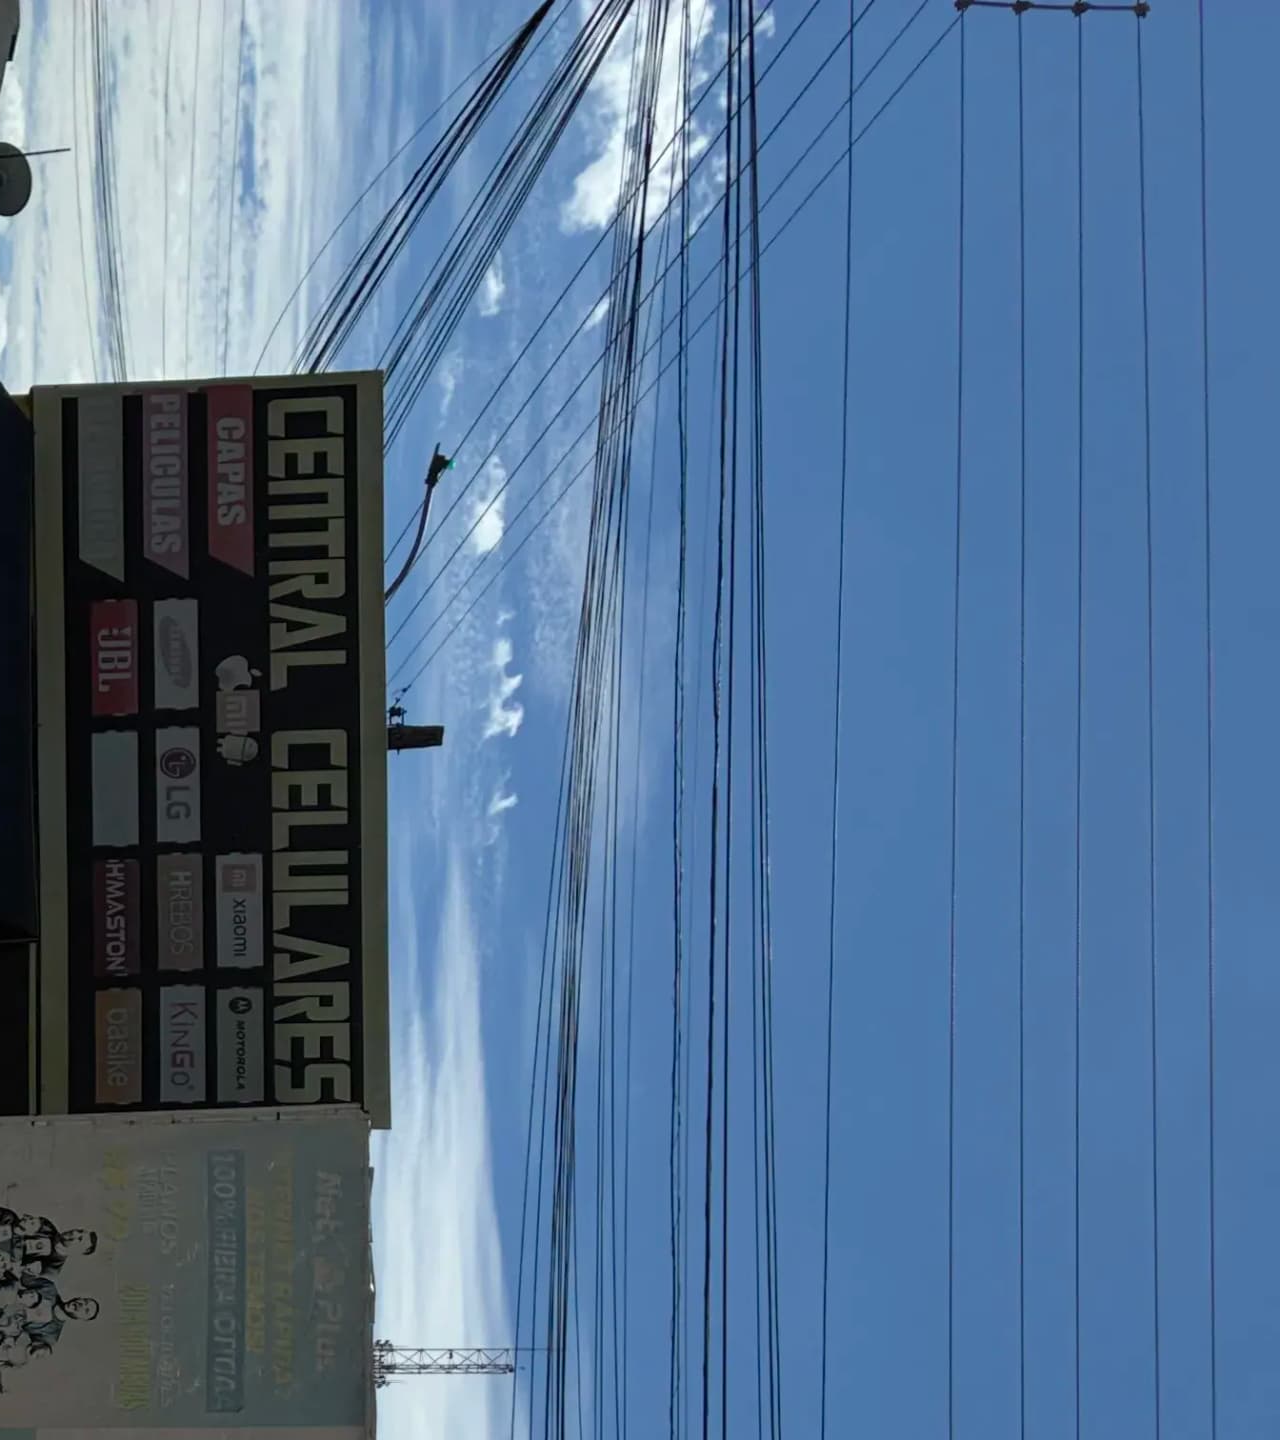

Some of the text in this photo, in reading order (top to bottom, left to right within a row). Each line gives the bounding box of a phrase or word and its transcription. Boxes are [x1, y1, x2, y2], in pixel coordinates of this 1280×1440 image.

[215, 416, 247, 527] CAPAS
[96, 628, 133, 692] JBL
[267, 396, 352, 1105] CENTRAL CELULARES
[165, 786, 191, 821] LG
[232, 898, 250, 959] xiaomi
